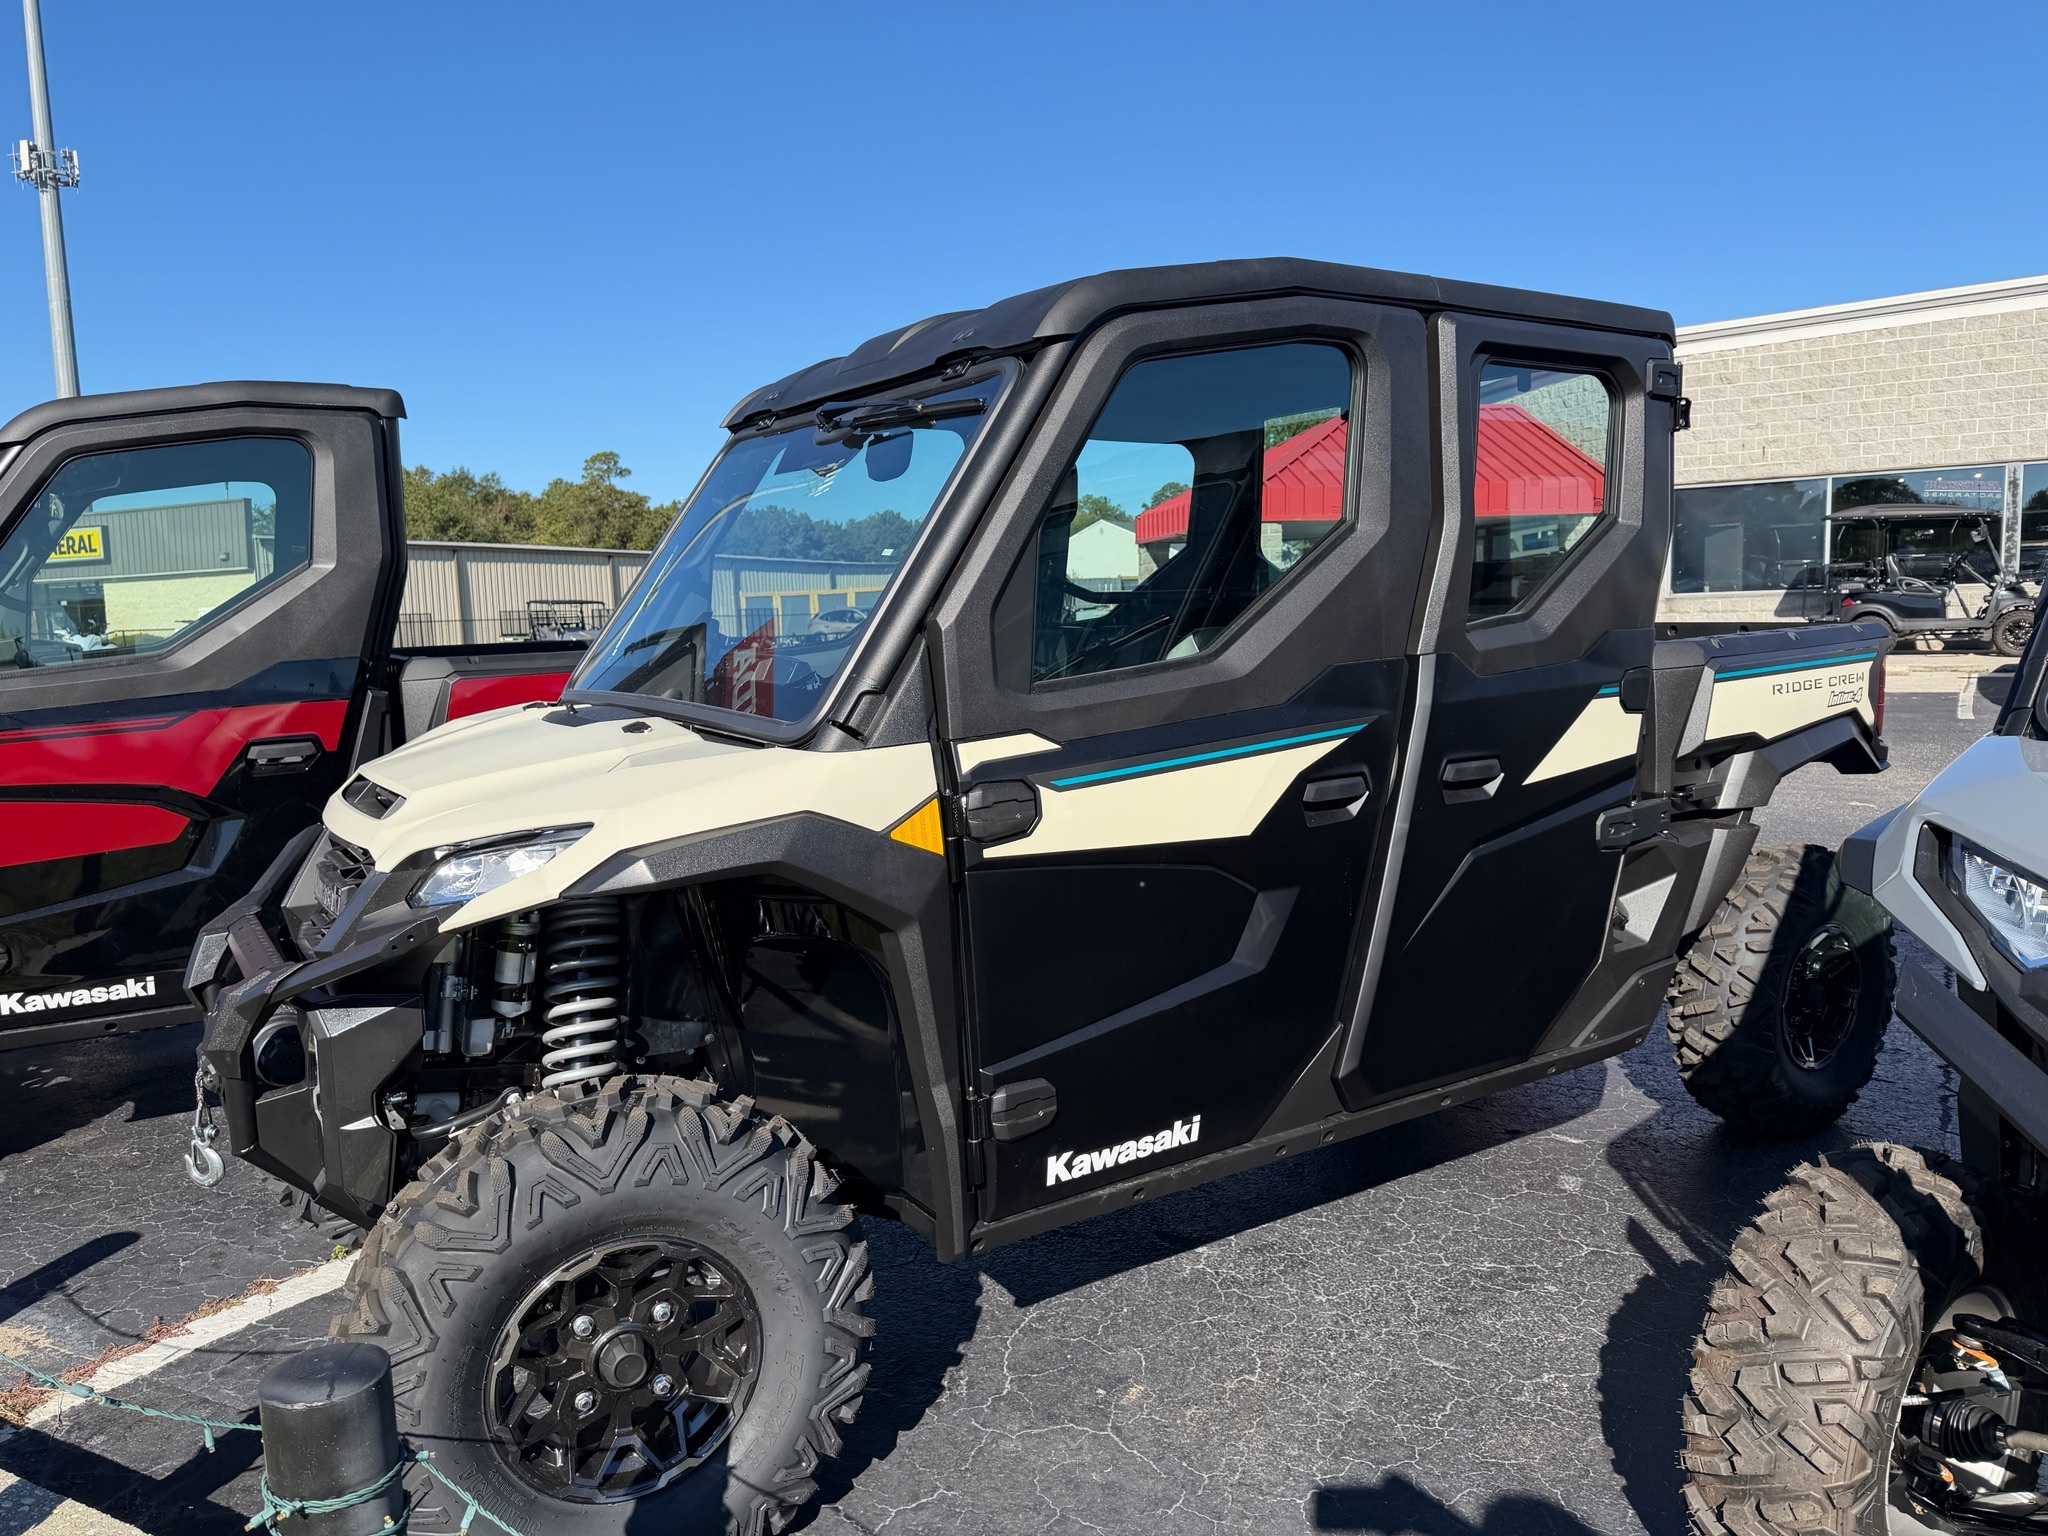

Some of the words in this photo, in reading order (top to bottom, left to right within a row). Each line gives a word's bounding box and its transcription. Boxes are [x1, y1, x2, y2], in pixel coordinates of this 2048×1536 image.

[1923, 491, 2002, 499] GENERATORS
[1772, 678, 1823, 695] RIDGE
[1828, 672, 1864, 687] CREW
[1827, 687, 1863, 708] Inline-4
[0, 976, 156, 1015] Kawasaki
[1046, 1115, 1201, 1187] Kawasaki
